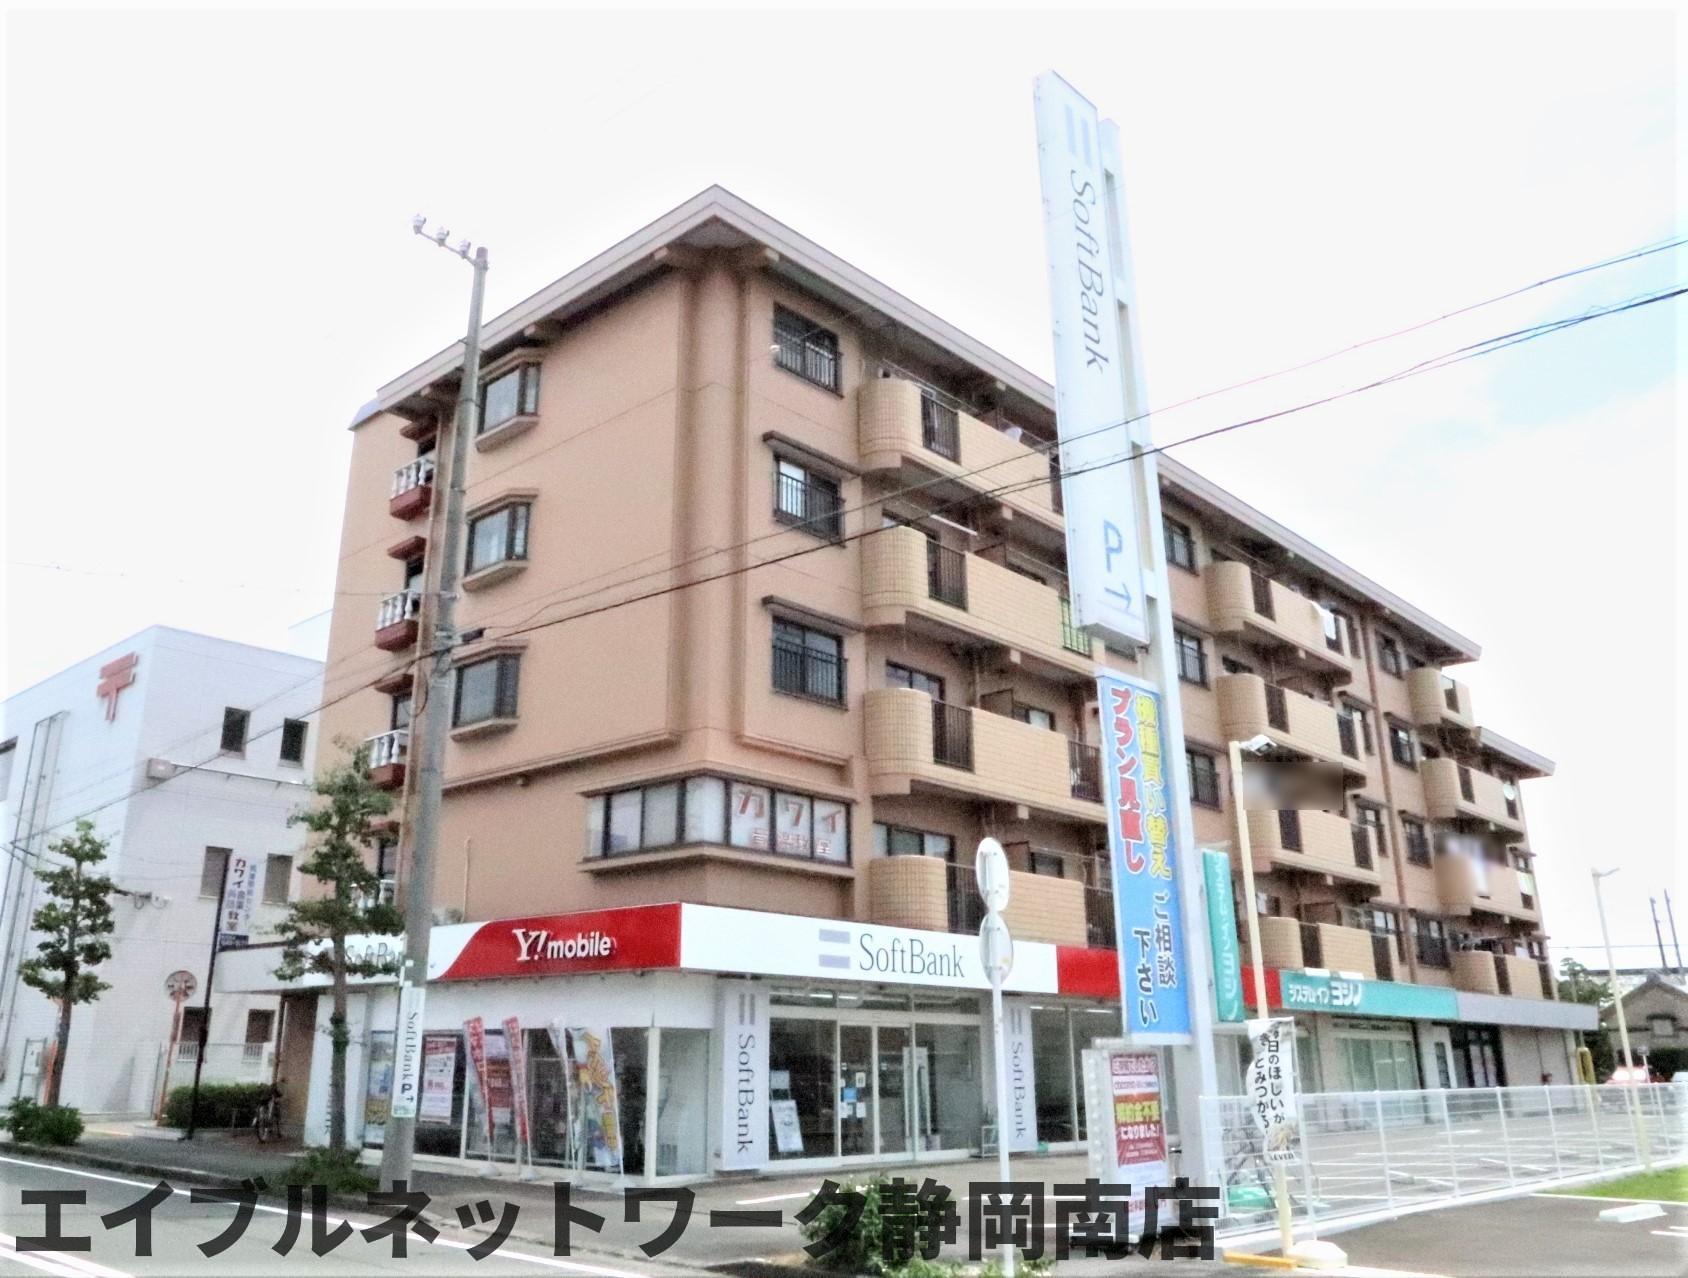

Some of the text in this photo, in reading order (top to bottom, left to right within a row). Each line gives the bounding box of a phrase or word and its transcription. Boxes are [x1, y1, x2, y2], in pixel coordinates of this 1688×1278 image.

[1070, 168, 1110, 375] SoftBank
[1103, 518, 1123, 574] P
[738, 789, 842, 834] カワイ
[1111, 686, 1145, 874] プラン見直し
[1133, 927, 1158, 1027] 下さい
[511, 927, 613, 963] Y!mobile
[859, 933, 966, 979] SoftBank
[1154, 888, 1177, 988] ご相談
[402, 1011, 418, 1081] SoftBank
[401, 1083, 413, 1094] P
[737, 1033, 756, 1154] SoftBank
[1011, 1041, 1026, 1139] SoftBank
